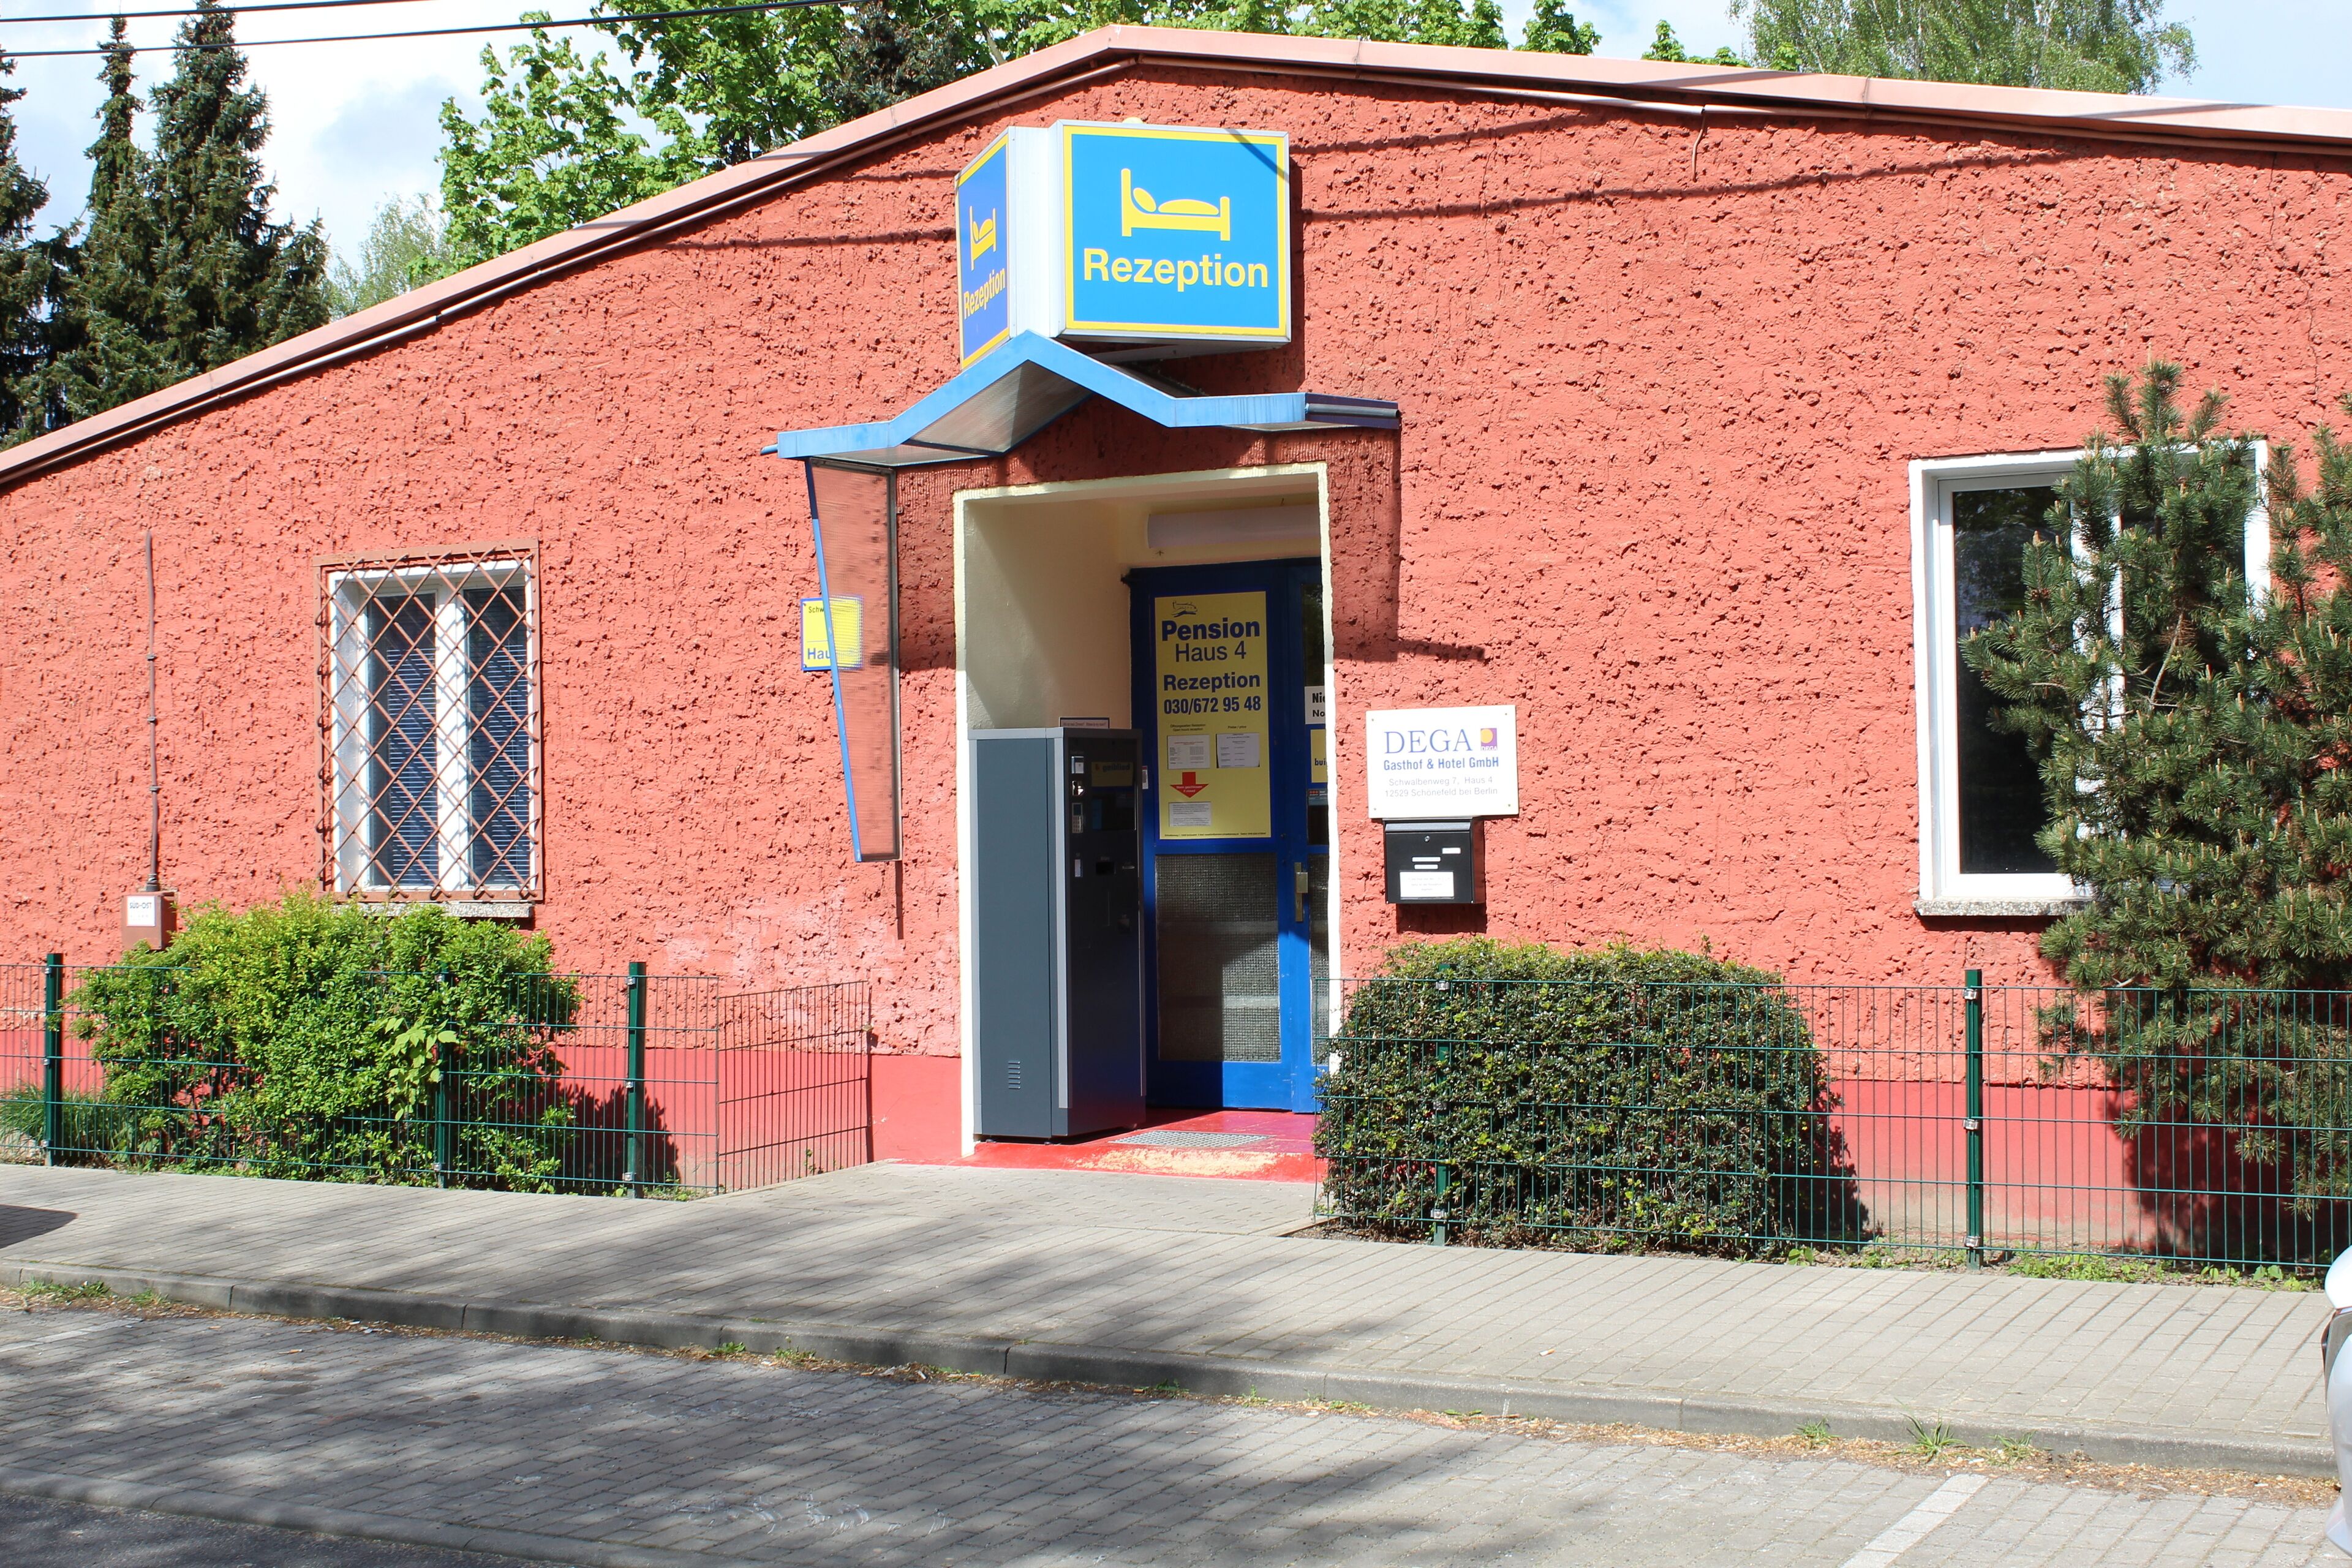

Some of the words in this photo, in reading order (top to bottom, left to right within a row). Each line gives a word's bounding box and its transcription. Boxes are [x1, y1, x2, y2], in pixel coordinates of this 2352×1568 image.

[1084, 248, 1268, 292] Rezeption
[963, 267, 1006, 320] Rezeption
[1162, 617, 1260, 641] Pension
[807, 647, 831, 660] Hau
[1175, 642, 1228, 662] Haus
[1234, 641, 1246, 660] 4
[1164, 672, 1261, 693] Rezeption
[1164, 697, 1218, 715] 030/672
[1223, 696, 1239, 712] 95
[1244, 695, 1261, 711] 48
[1384, 728, 1473, 754] DEGA
[1384, 758, 1423, 771] Gasthof
[1427, 758, 1434, 769] &
[1438, 757, 1465, 769] Hotel
[1469, 756, 1499, 768] GmbH
[1385, 789, 1409, 797] 12529
[1411, 788, 1457, 797] Schönefeld
[1389, 778, 1450, 786] Schwalbenweg
